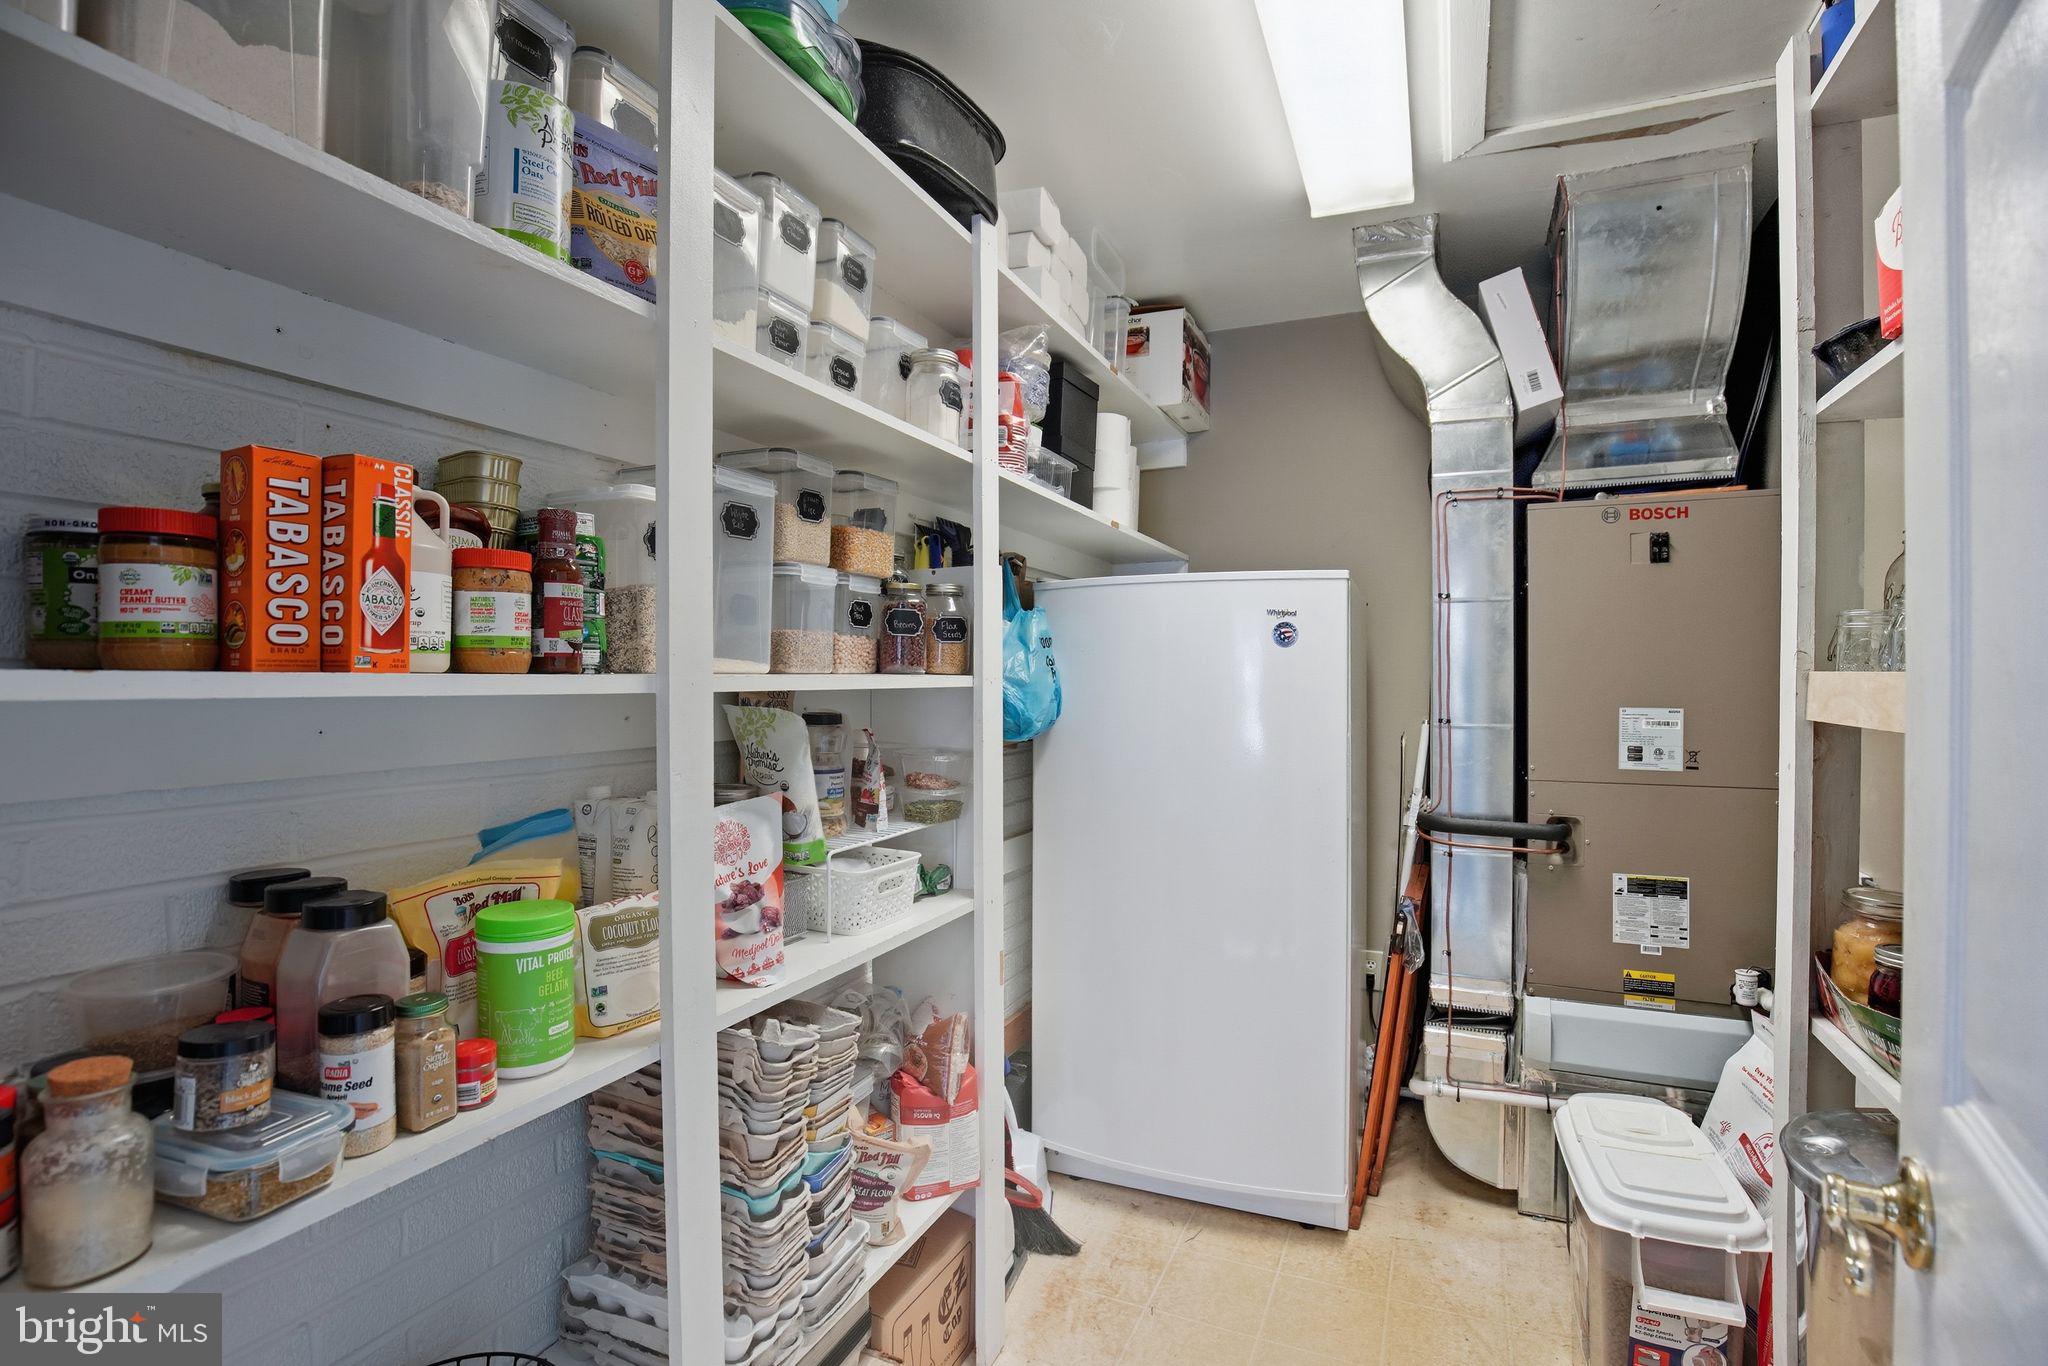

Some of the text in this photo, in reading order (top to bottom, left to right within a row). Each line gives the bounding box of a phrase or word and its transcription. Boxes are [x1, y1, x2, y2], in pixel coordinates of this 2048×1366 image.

[521, 155, 558, 176] Steel Cu
[521, 166, 544, 180] Oats
[586, 204, 632, 238] ROLLED
[634, 226, 657, 246] OAT
[606, 209, 657, 228] FASHIONE
[393, 465, 412, 538] CLASSIC
[1628, 506, 1689, 521] BOSCH
[265, 477, 310, 646] TABASCO
[321, 478, 348, 646] TABASCO
[72, 569, 97, 580] On
[119, 588, 155, 596] CREAMY
[119, 596, 187, 605] PEANUT BUTTER
[361, 593, 404, 607] TABASCO
[563, 606, 583, 622] CLASS
[1266, 608, 1298, 618] Whirlpool
[940, 620, 958, 630] Flax
[942, 630, 962, 639] Seeds
[270, 647, 305, 655] BRAND
[745, 742, 780, 762] Nature's
[747, 758, 785, 773] Promise
[714, 858, 769, 888] ature's Love
[614, 910, 652, 922] ORGANIC
[602, 916, 660, 941] COCONUT FLOU
[731, 938, 769, 960] Medjool
[515, 955, 545, 975] VITAL
[546, 966, 565, 983] BEEF
[538, 978, 569, 997] GELATIN
[325, 1068, 349, 1079] BADIA
[321, 1076, 374, 1092] same Seed
[860, 1151, 881, 1164] Red
[852, 1184, 894, 1198] HEAT FLOUR
